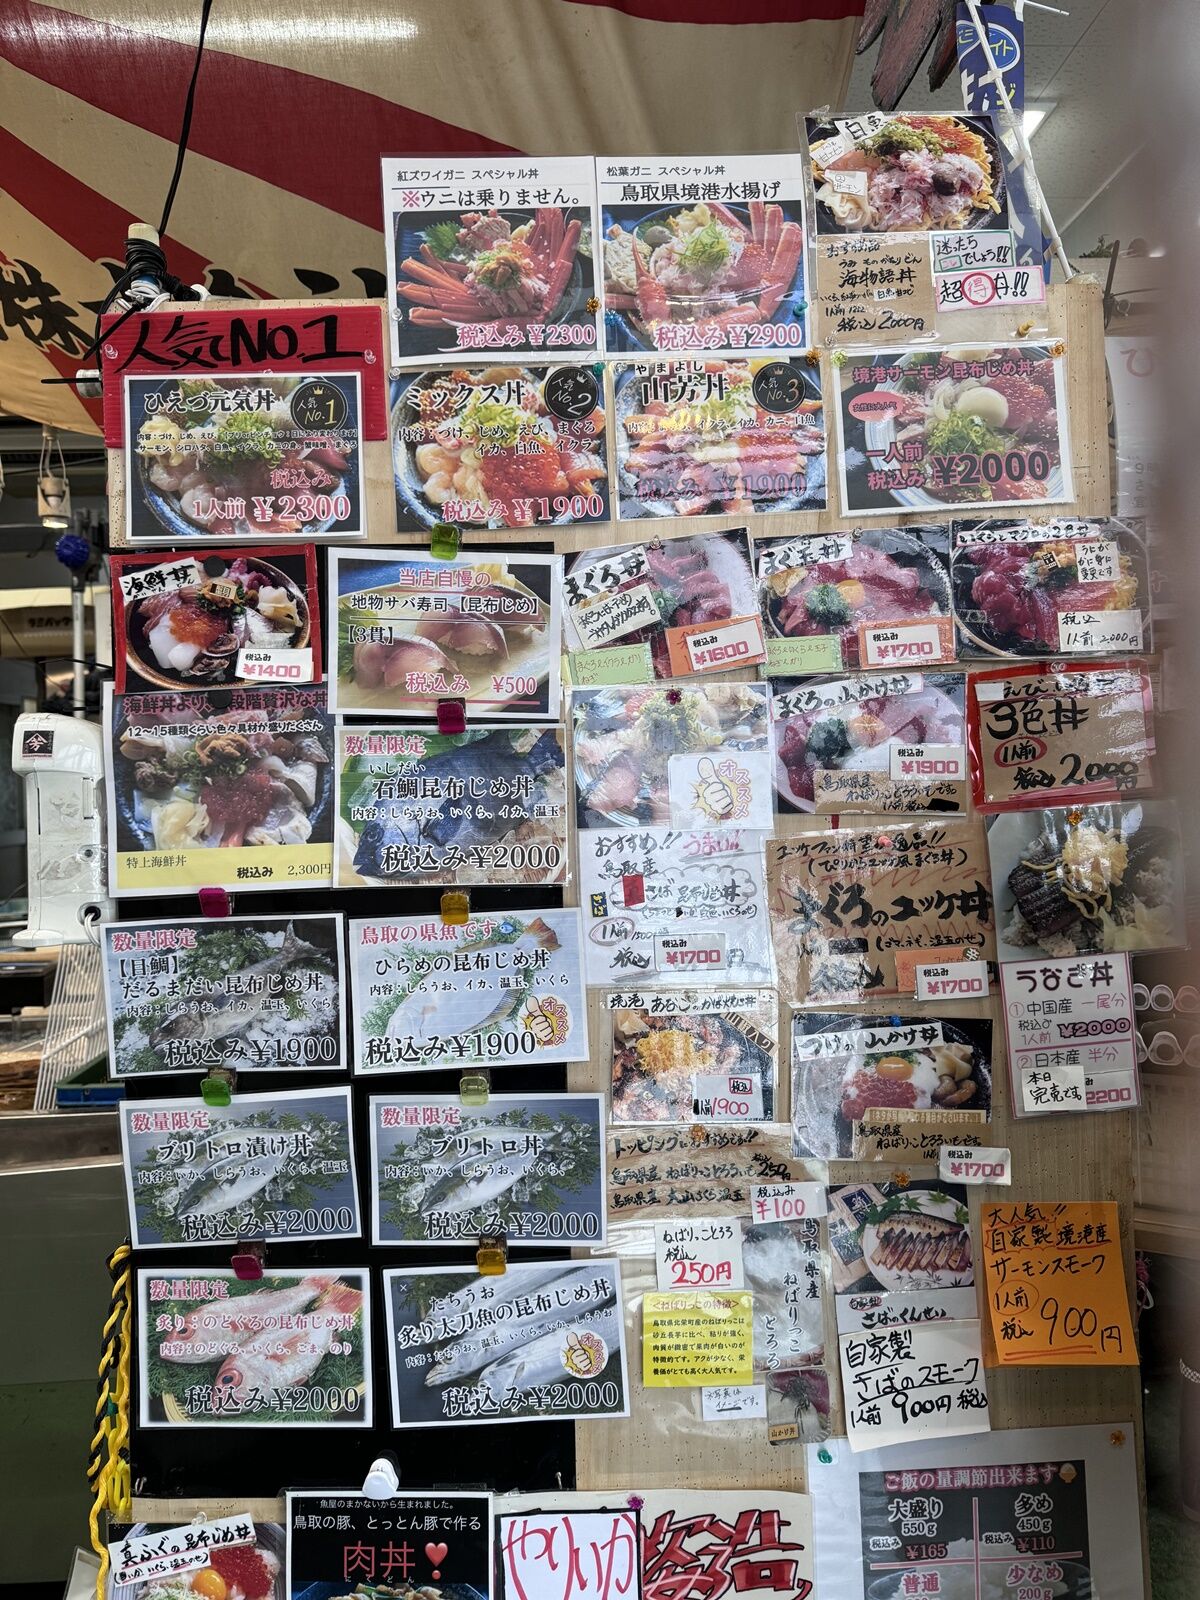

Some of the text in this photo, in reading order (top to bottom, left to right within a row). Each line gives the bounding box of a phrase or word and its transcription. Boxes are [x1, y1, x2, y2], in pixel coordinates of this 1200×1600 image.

[397, 168, 539, 182] 紅ズワイガニ スペシャル丼
[606, 165, 725, 176] 松葉ガニ スペシャル丼
[620, 181, 781, 202] 鳥取県境港水揚げ
[839, 267, 916, 288] 海物語丼
[879, 310, 925, 331] 2000円
[636, 361, 703, 376] やまよし
[853, 359, 1033, 384] 境港サーモン昆布じめ丼
[406, 380, 526, 410] ミックス丼
[642, 374, 729, 405] 山芳丼
[758, 377, 778, 392] 人気
[767, 378, 799, 404] No.3
[144, 390, 275, 413] ひえづ元気丼
[298, 398, 317, 409] 人気
[305, 400, 337, 425] No.1
[552, 390, 592, 416] No.2
[853, 402, 897, 412] 女性に大人気
[866, 444, 922, 463] 一人前
[270, 469, 331, 489] 税込み
[868, 451, 1050, 491] 税込み ¥2000
[193, 495, 351, 522] 1人前 ¥2300
[123, 564, 196, 596] 海鮮丼
[400, 569, 491, 587] 当店自慢の
[565, 552, 645, 606] まぐろ丼
[349, 626, 394, 644] 【3貫】
[693, 636, 718, 647] 税込み
[873, 633, 898, 642] 税込み
[245, 653, 272, 661] 税込み
[695, 641, 749, 665] ¥1600
[878, 642, 933, 658] ¥1700
[243, 664, 300, 678] ¥1400
[406, 672, 537, 694] 税込み ¥500
[124, 690, 328, 715] 海鮮丼より、段階贅沢な丼
[778, 675, 912, 718] まぐろの山かけ丼
[986, 697, 1090, 740] 3色丼
[345, 735, 427, 756] 数量限定
[898, 749, 924, 757] 税込み
[1003, 741, 1036, 763] 1人前
[370, 762, 426, 775] いしだい
[902, 760, 959, 774] ¥1900
[373, 776, 534, 800] 石鯛昆布じめ丼
[718, 760, 751, 819] オススメ
[126, 855, 187, 868] 特上海鮮丼
[237, 863, 331, 878] 税込み 2,300円
[112, 928, 197, 952] 数量限定
[360, 919, 497, 945] 鳥取の県魚です
[662, 940, 687, 948] 税込み
[119, 955, 179, 978] 【目鯛】
[375, 948, 550, 976] ひらめの昆布じめ丼
[666, 950, 721, 964] ¥1700
[924, 968, 949, 977] 税込み
[1016, 961, 1114, 993] うなぎ丼
[123, 973, 323, 999] だるまだい昆布じめ丼
[928, 978, 983, 995] ¥1700
[543, 997, 570, 1045] オススメ
[1057, 1017, 1130, 1038] ¥2000
[1022, 1031, 1051, 1045] 1人前
[1089, 1047, 1118, 1062] 半分
[1027, 1071, 1051, 1084] 本日
[1030, 1083, 1083, 1105] 完売です。
[132, 1110, 210, 1134] 数量限定
[381, 1106, 461, 1128] 数量限定
[157, 1132, 313, 1163] ブリトロ漬け丼
[432, 1134, 544, 1158] ブリトロ丼
[948, 1151, 973, 1159] 税込み
[951, 1163, 1005, 1177] ¥1700
[757, 1186, 796, 1198] 税込み
[756, 1199, 806, 1221] ¥100
[992, 1224, 1053, 1252] 自家製
[802, 1218, 821, 1299] 鳥取県産
[990, 1255, 1105, 1283] サーモンスモーク
[671, 1260, 732, 1285] 250円
[150, 1280, 230, 1301] 数量限定
[430, 1285, 495, 1312] たちうお
[995, 1287, 1029, 1311] 1人前
[155, 1314, 355, 1332] 炙り：のどぐろの昆布じめ丼
[397, 1277, 612, 1350] 炙り太刀魚の昆布じめ丼
[783, 1271, 804, 1354] ねばりっこ
[764, 1315, 781, 1370] とろろ
[846, 1329, 915, 1368] 自家製
[853, 1358, 979, 1401] さばのスモーク
[885, 1465, 1058, 1492] ご飯の量調節出来ます
[320, 1500, 454, 1509] 魚屋のまかないから生まれました。
[888, 1498, 943, 1522] 大盛り
[1015, 1493, 1053, 1516] 多め
[293, 1515, 481, 1531] 鳥取の豚、とっとん豚で作る
[901, 1521, 937, 1536] 550g
[1016, 1518, 1051, 1532] 450g
[120, 1523, 251, 1567] 真ふぐの昆布じめ丼
[870, 1538, 946, 1560] 税込み ¥165
[983, 1533, 1055, 1552] 税込み ¥110
[343, 1540, 415, 1579] 肉丼
[901, 1573, 941, 1596] 普通
[1007, 1563, 1064, 1586] 少なめ
